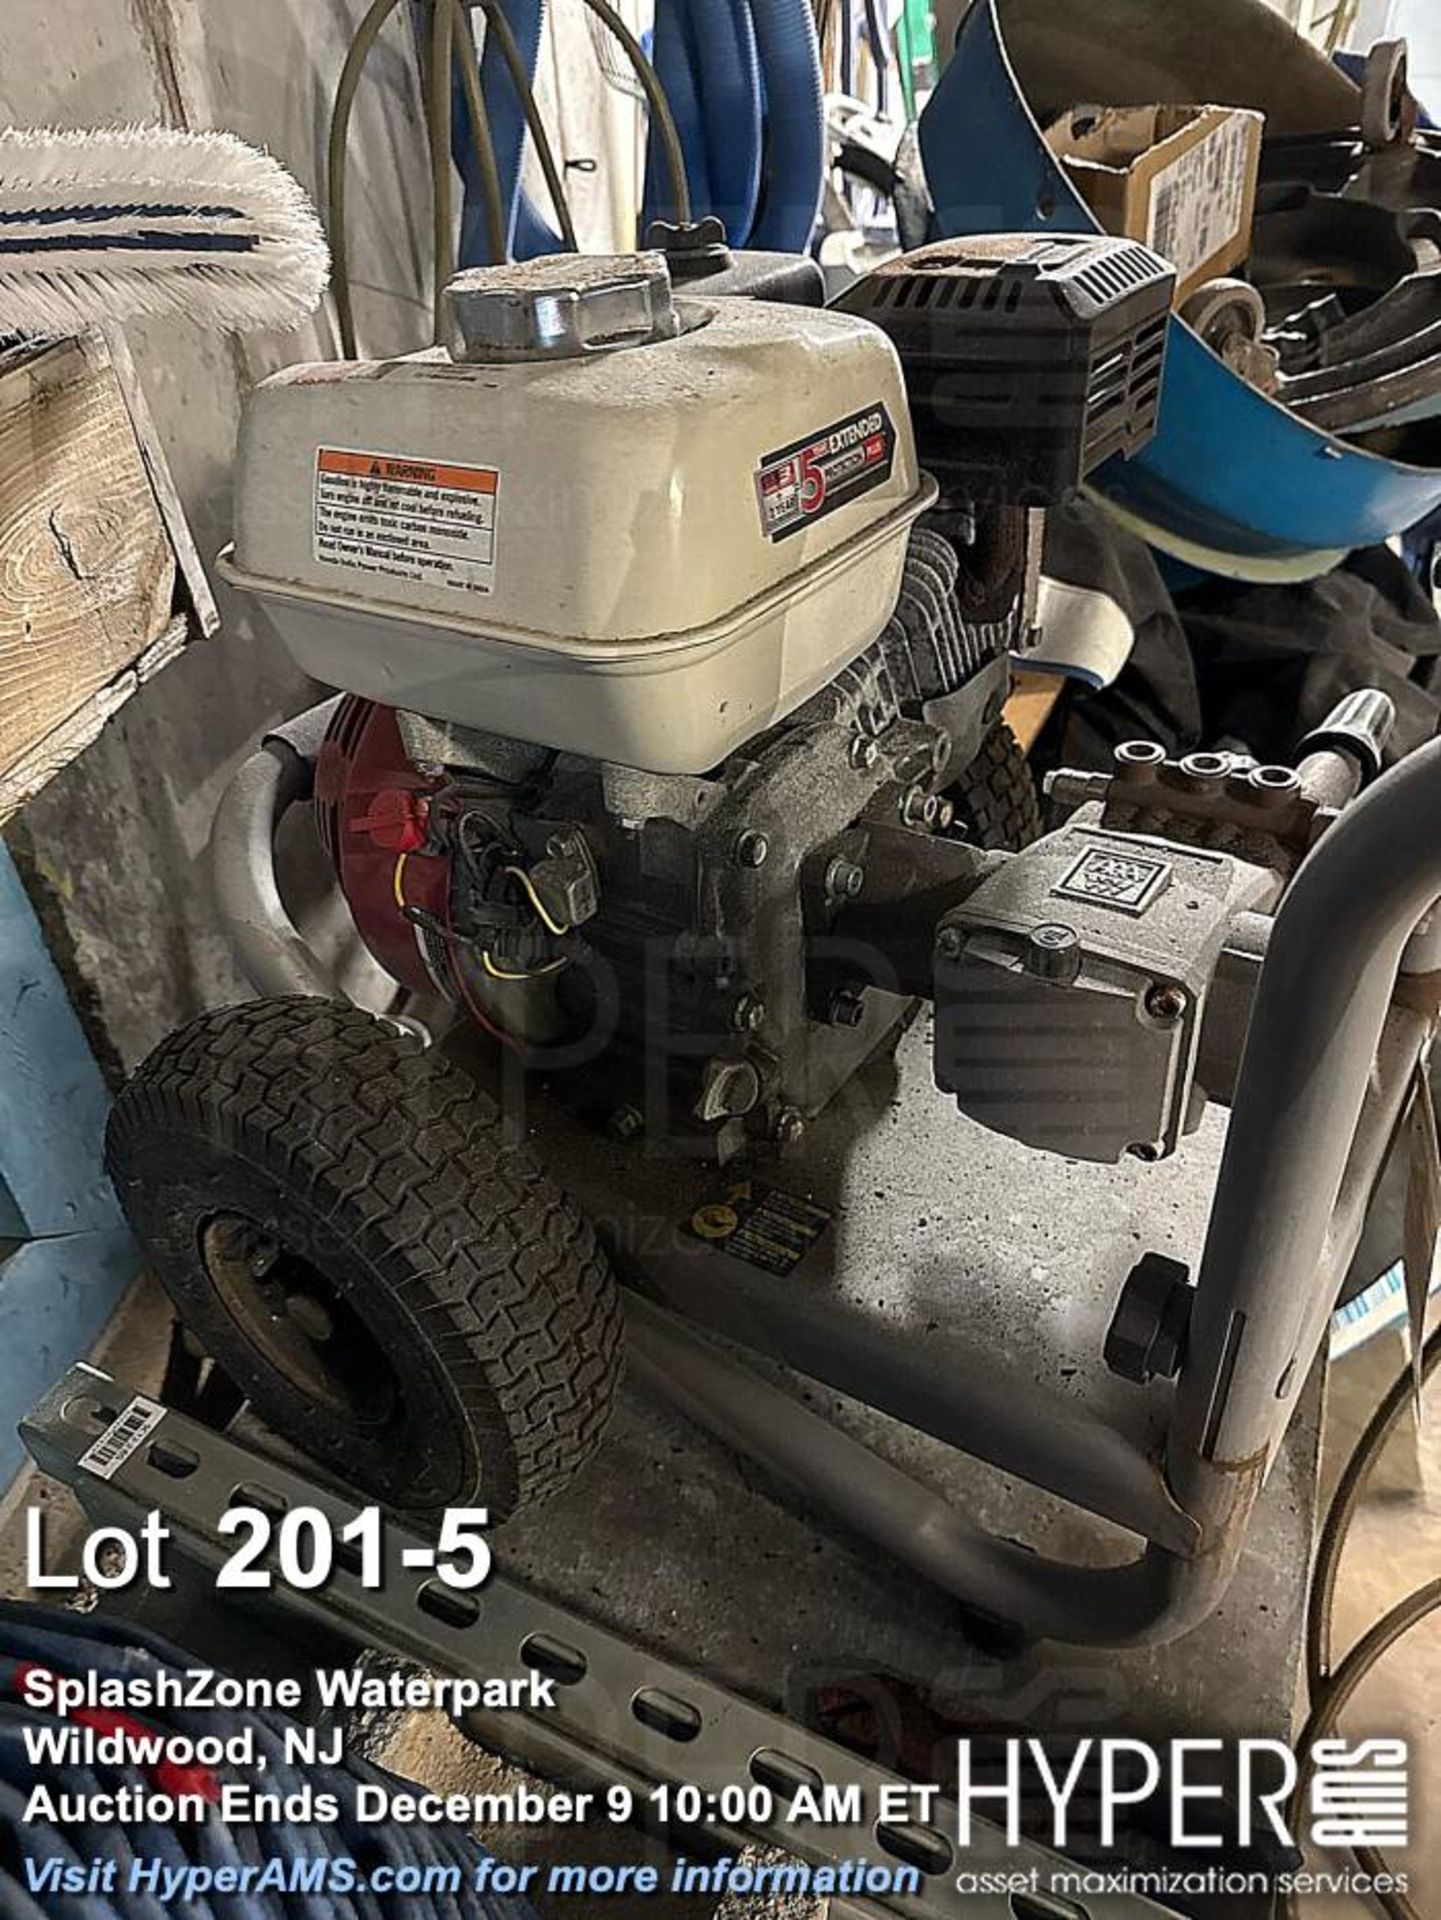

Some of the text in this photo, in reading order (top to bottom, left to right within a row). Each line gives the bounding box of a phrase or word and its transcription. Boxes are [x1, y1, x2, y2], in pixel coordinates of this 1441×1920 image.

[829, 412, 882, 454] EXTENDED
[385, 462, 435, 481] WARNING
[800, 449, 826, 513] 5
[320, 506, 332, 517] The
